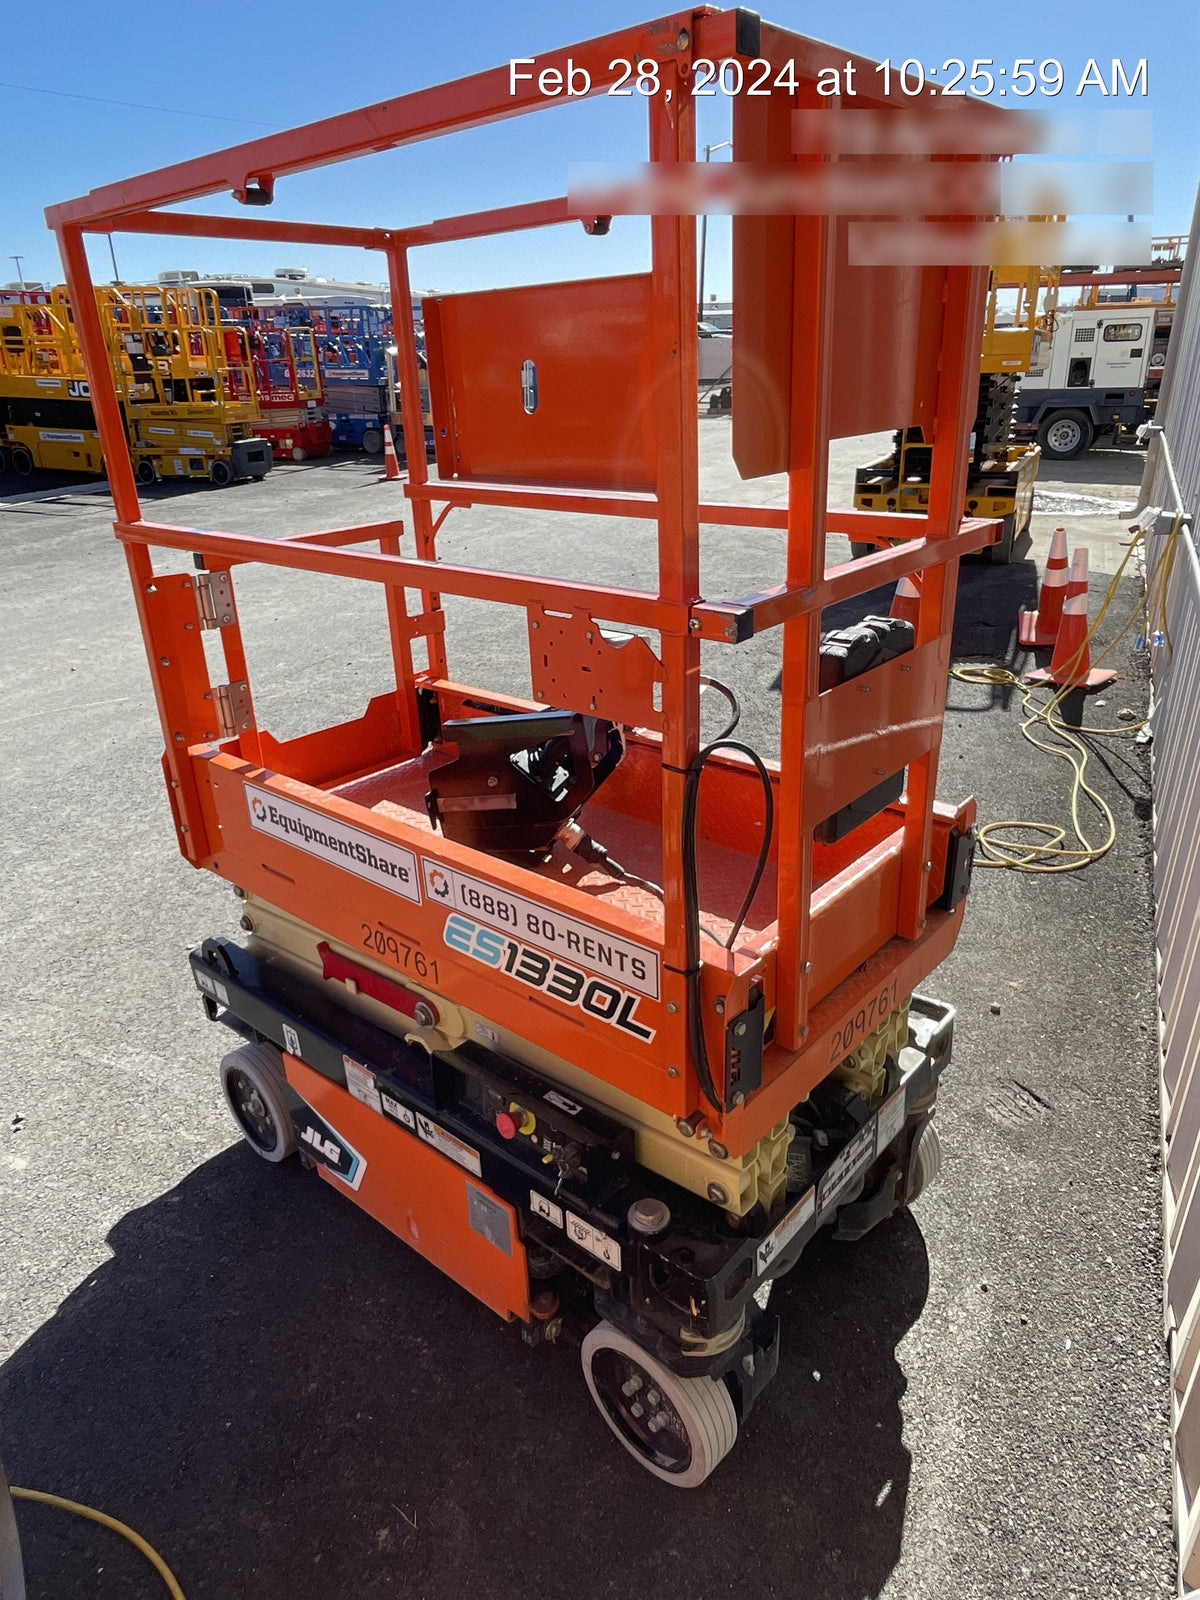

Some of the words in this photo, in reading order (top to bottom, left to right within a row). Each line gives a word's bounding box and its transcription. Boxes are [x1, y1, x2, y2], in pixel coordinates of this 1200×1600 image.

[69, 381, 91, 396] JC
[268, 804, 410, 884] EquipmentShare
[361, 922, 439, 985] 209761
[462, 882, 518, 927] (888)
[526, 912, 647, 981] 80-RENTS
[446, 916, 655, 1040] ES1330L
[831, 981, 898, 1064] 209761
[300, 1125, 341, 1164] JLG
